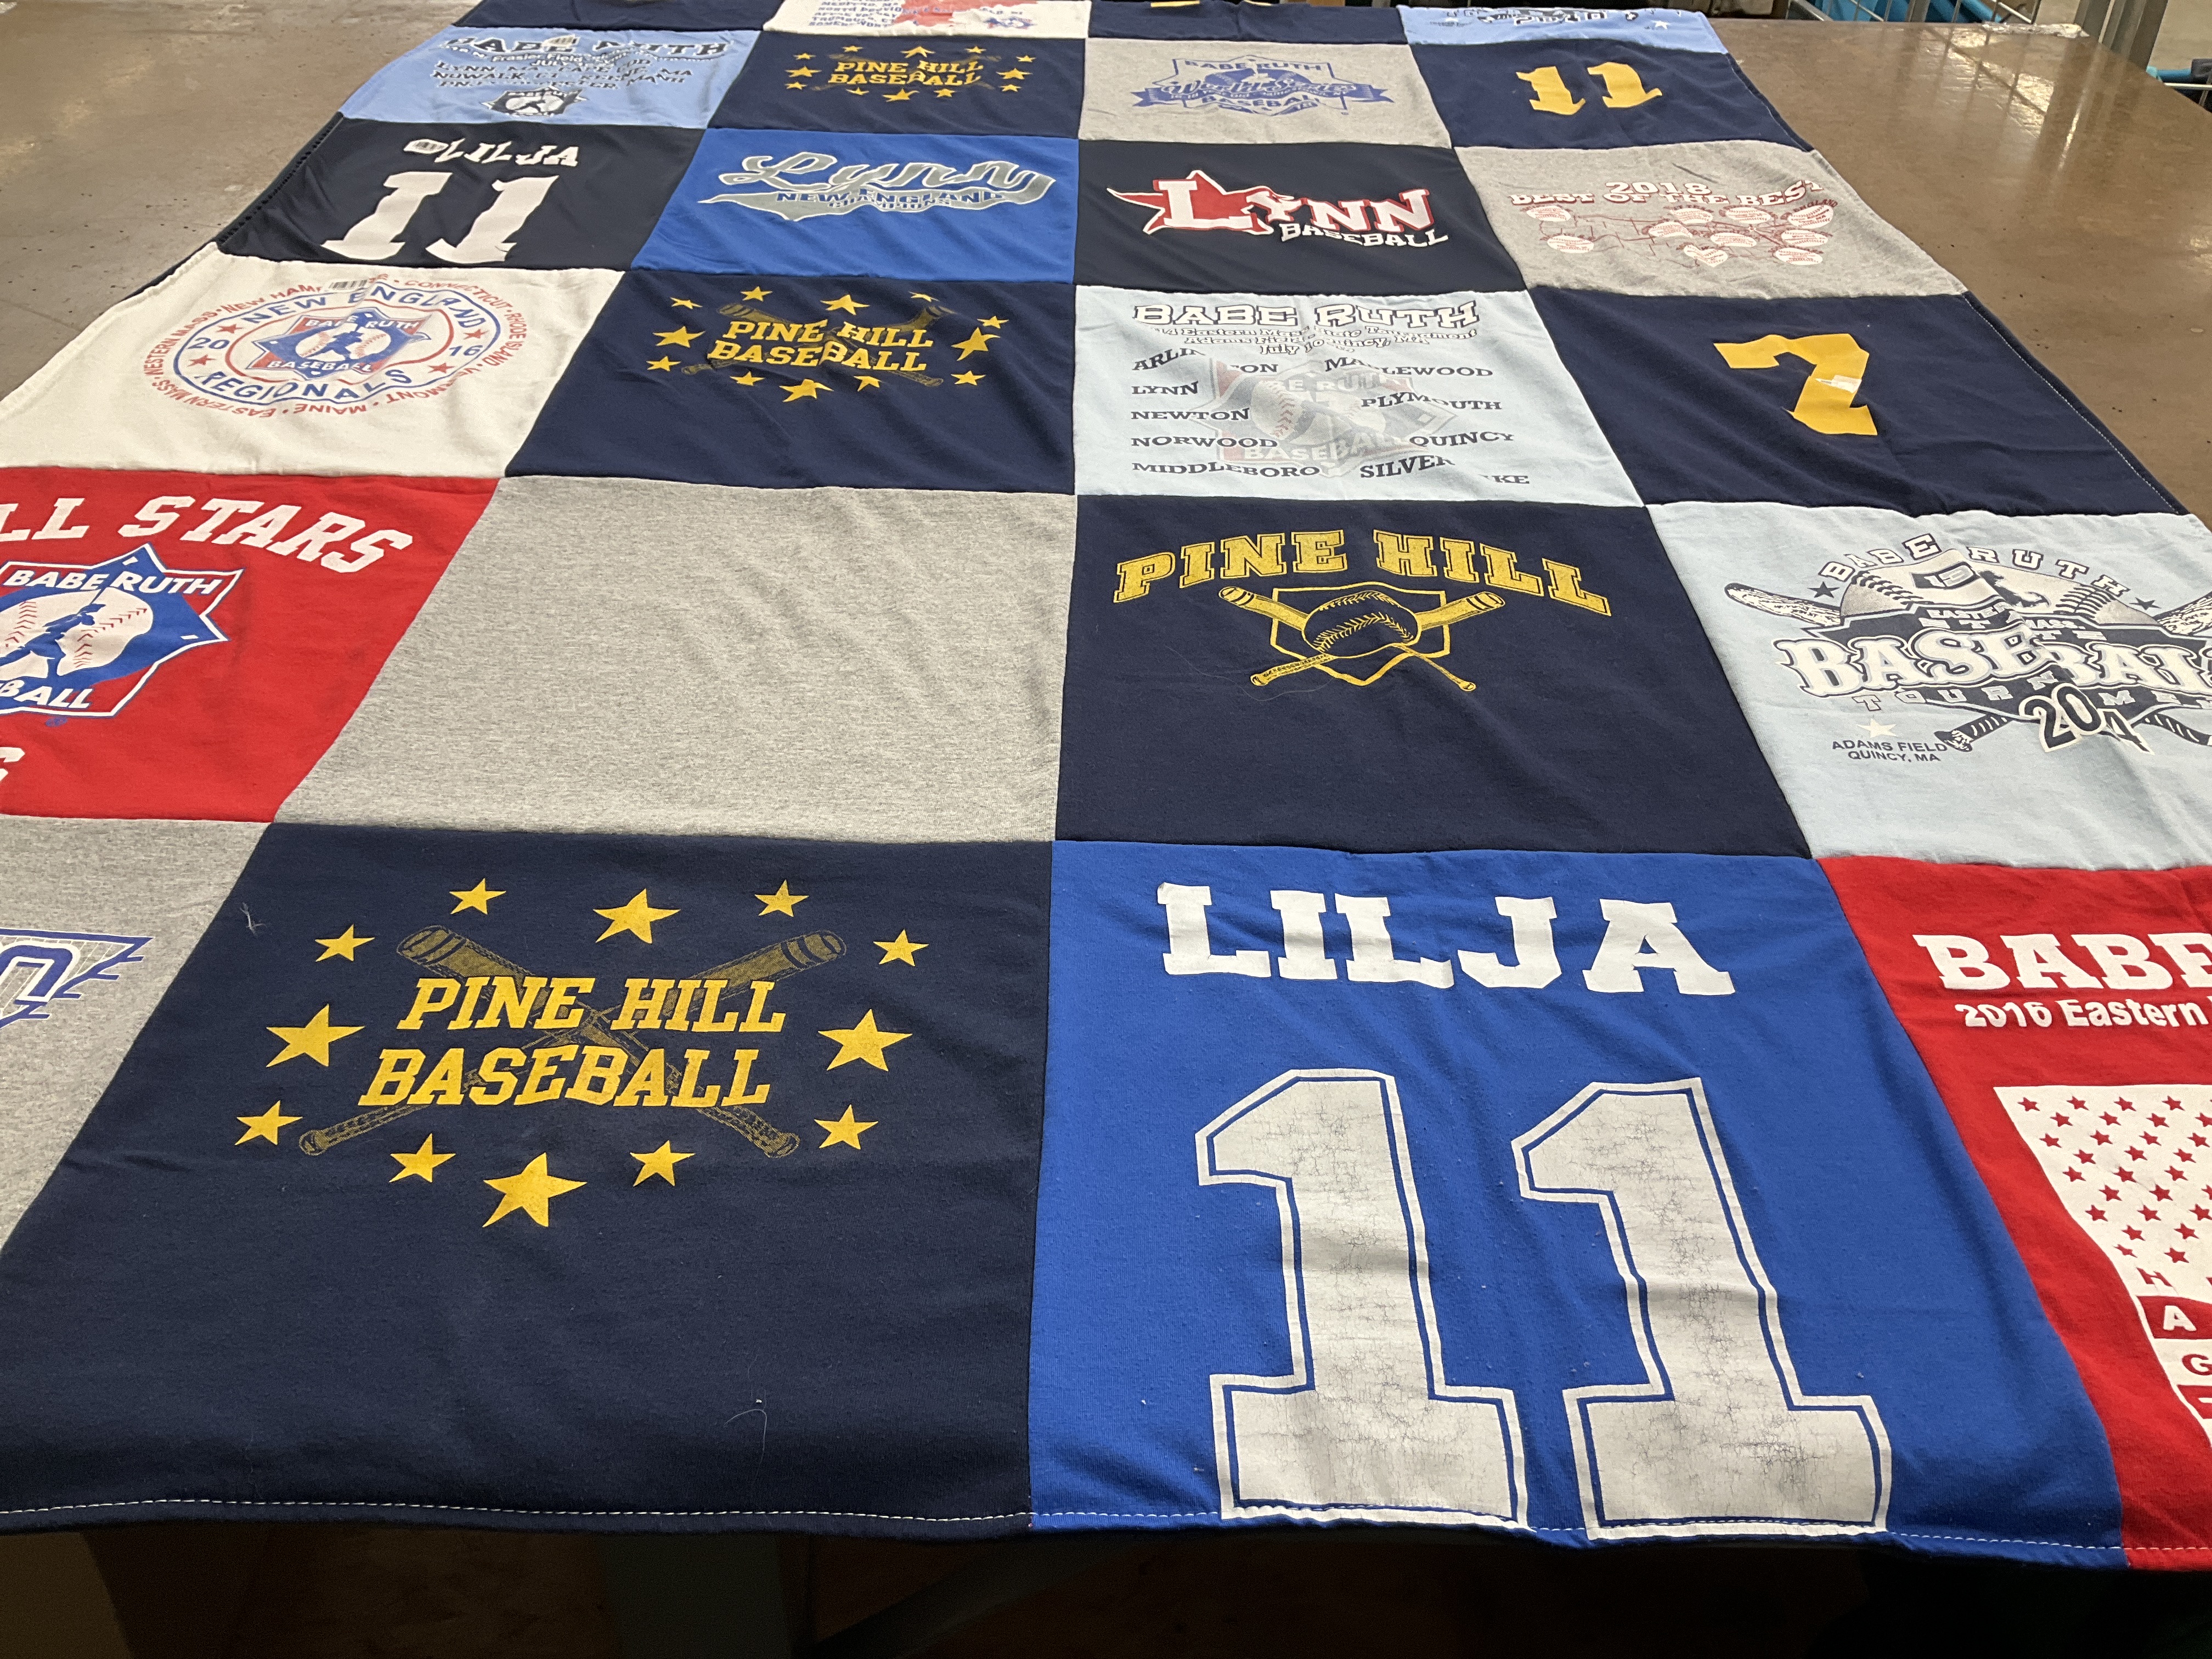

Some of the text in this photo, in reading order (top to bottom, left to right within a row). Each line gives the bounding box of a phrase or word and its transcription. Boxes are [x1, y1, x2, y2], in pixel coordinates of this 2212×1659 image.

[827, 71, 983, 87] BASEBALL
[834, 60, 985, 74] PINE HILL
[1184, 60, 1322, 71] BABE RUTH
[1515, 61, 1663, 115] 11
[435, 138, 579, 167] LILJA
[718, 151, 1057, 202] Lynn
[1605, 182, 1712, 196] 2018
[776, 188, 1006, 204] NEW ENGLAND
[1153, 179, 1430, 233] LYNN
[1509, 179, 1825, 207] BEST OF THE BEST
[320, 171, 560, 263] 11
[1280, 223, 1449, 247] BASEBALL
[221, 297, 267, 313] NEW
[241, 285, 487, 329] NEW ENGLAND
[404, 280, 513, 309] CONNECTICUT
[305, 315, 420, 329] BAE RUTH
[1132, 300, 1480, 329] BABE RUTH
[187, 337, 230, 350] 20
[482, 312, 528, 367] RHODE ISLAND
[721, 319, 934, 348] PINE HILL
[1181, 328, 1257, 336] Eastern
[1255, 336, 1305, 345] Field
[1394, 335, 1430, 345] MA
[707, 339, 929, 373] BASEBALL
[1260, 343, 1300, 356] July
[1324, 357, 1494, 376] MALEWOOD
[194, 369, 413, 400] REGIONALS
[1131, 380, 1199, 395] LYNN
[1713, 332, 1878, 436] 7
[294, 403, 366, 415] MAINE
[1131, 407, 1250, 421] NEWTON
[1361, 391, 1503, 410] PLYMOUTH
[1131, 436, 1278, 448] NORWOOD
[1409, 431, 1515, 448] QUINCY
[1132, 461, 1321, 478] MIDDLEBORO
[1359, 454, 1456, 479] SILVER
[0, 495, 414, 574] LL STARS
[1113, 528, 1612, 617] PINE HILL
[1818, 533, 2131, 598] BABE RUTH
[3, 569, 222, 595] BABE RUTH
[1926, 600, 2024, 619] EASTER
[1773, 628, 2212, 698] BASEBAL
[0, 679, 94, 710] BALL
[1832, 739, 1948, 753] ADAMS FIELD
[1848, 750, 1941, 763] QUINCY, MA
[1156, 881, 1736, 996] LILJA
[1912, 932, 2212, 991] BABE
[396, 976, 787, 1034] PINE HILL
[1955, 998, 2209, 1028] 2016 Eastern
[357, 1043, 772, 1109] BASEBALL
[1194, 1067, 1893, 1542] 11
